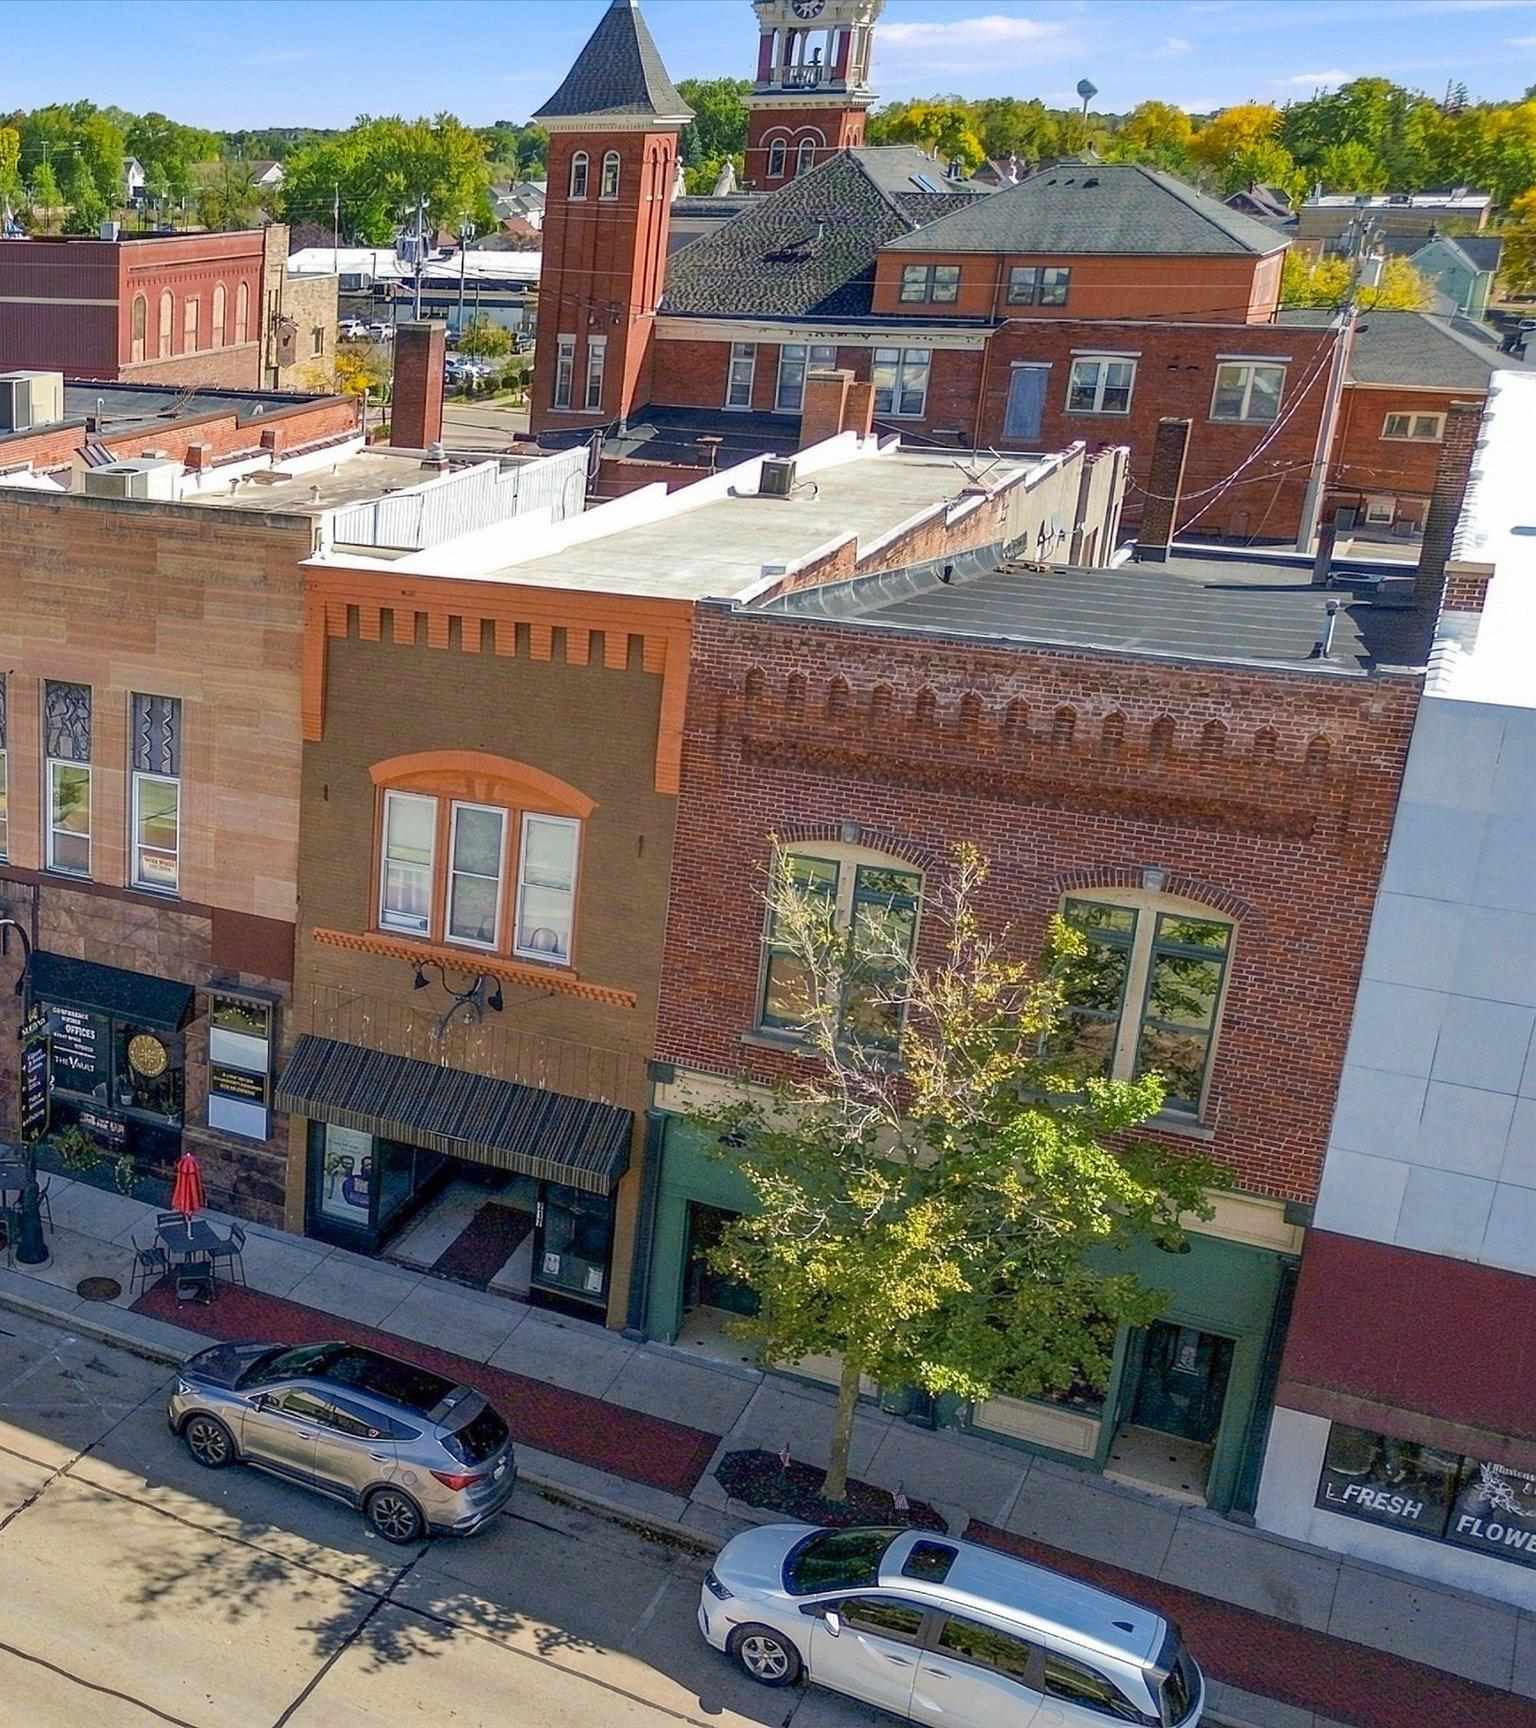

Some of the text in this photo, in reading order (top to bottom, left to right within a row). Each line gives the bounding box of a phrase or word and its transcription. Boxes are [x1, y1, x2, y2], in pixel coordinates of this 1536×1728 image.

[65, 1023, 95, 1039] OFFICES
[68, 1056, 95, 1072] VAULT
[1342, 1483, 1423, 1519] FRESH
